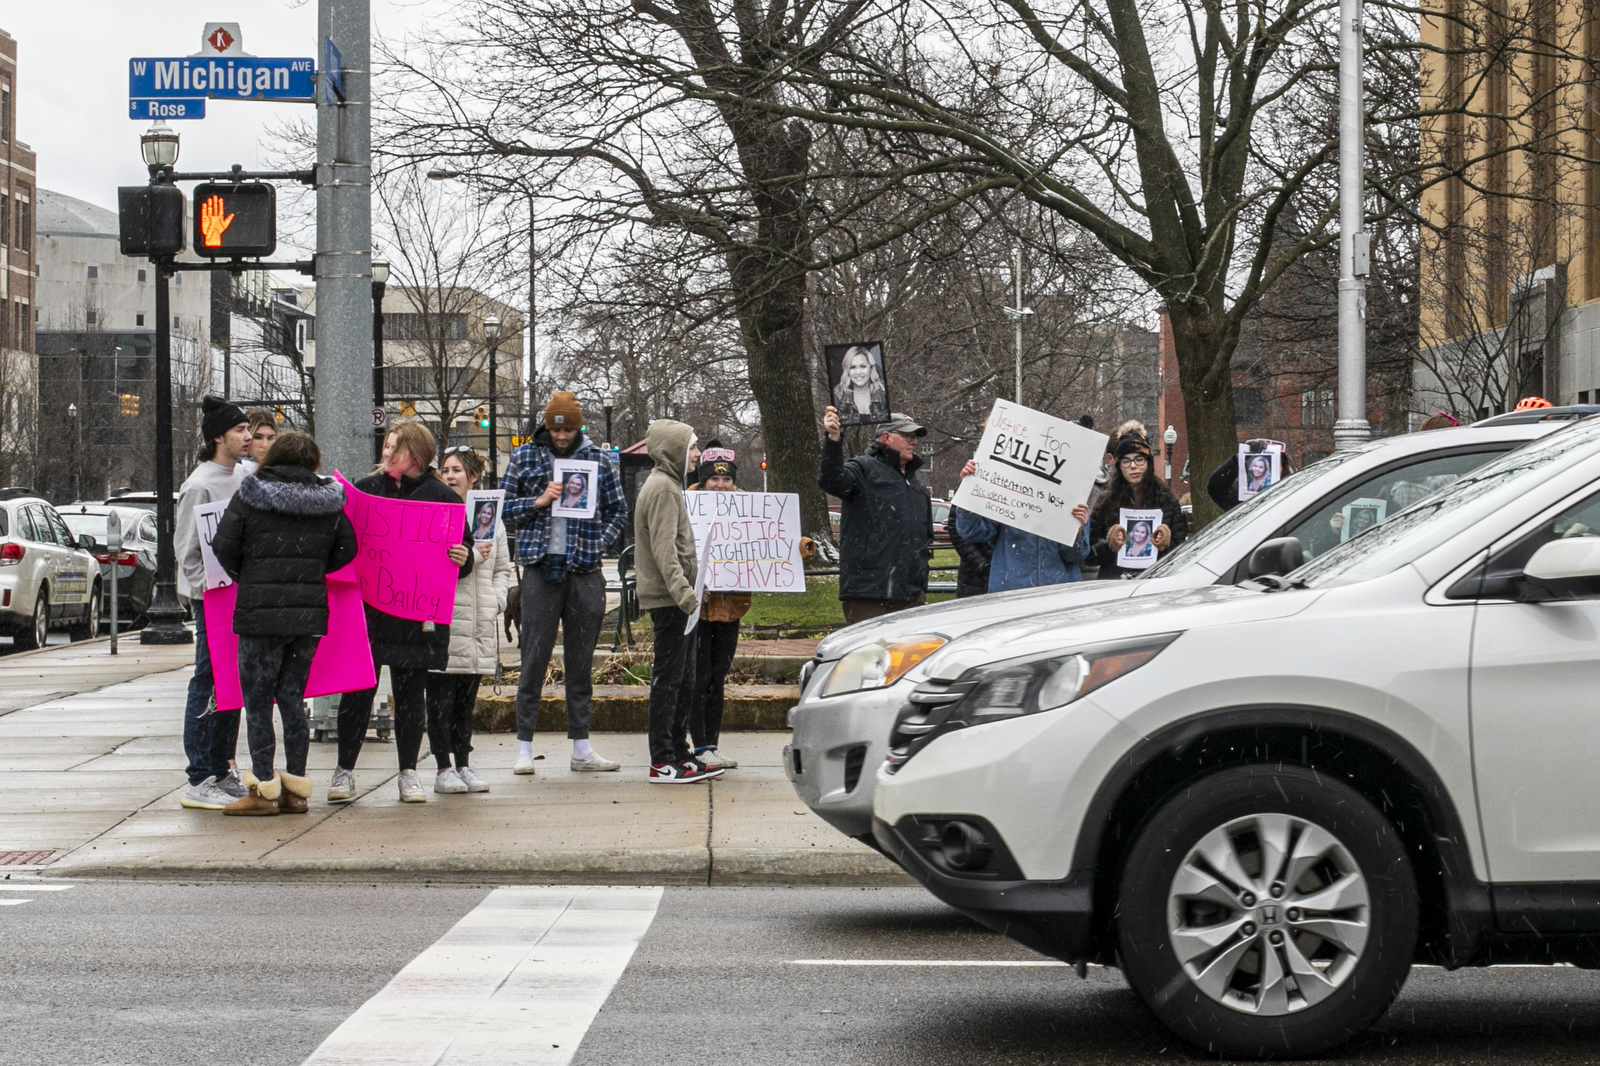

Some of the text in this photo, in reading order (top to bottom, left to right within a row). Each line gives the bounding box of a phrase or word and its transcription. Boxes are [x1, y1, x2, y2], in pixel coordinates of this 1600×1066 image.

[216, 32, 226, 47] K
[132, 61, 312, 97] W Michigan AVE
[131, 101, 187, 117] S Rose
[1040, 426, 1071, 455] for
[993, 433, 1067, 479] BAILEY
[716, 492, 789, 523] BAILEY
[1011, 498, 1043, 514] comes
[1036, 488, 1046, 500] is
[1048, 492, 1065, 509] lost
[345, 488, 466, 544] USTICE
[985, 501, 1016, 520] across
[707, 521, 786, 541] JUSTICE
[710, 539, 794, 562] RIGHTFULLY
